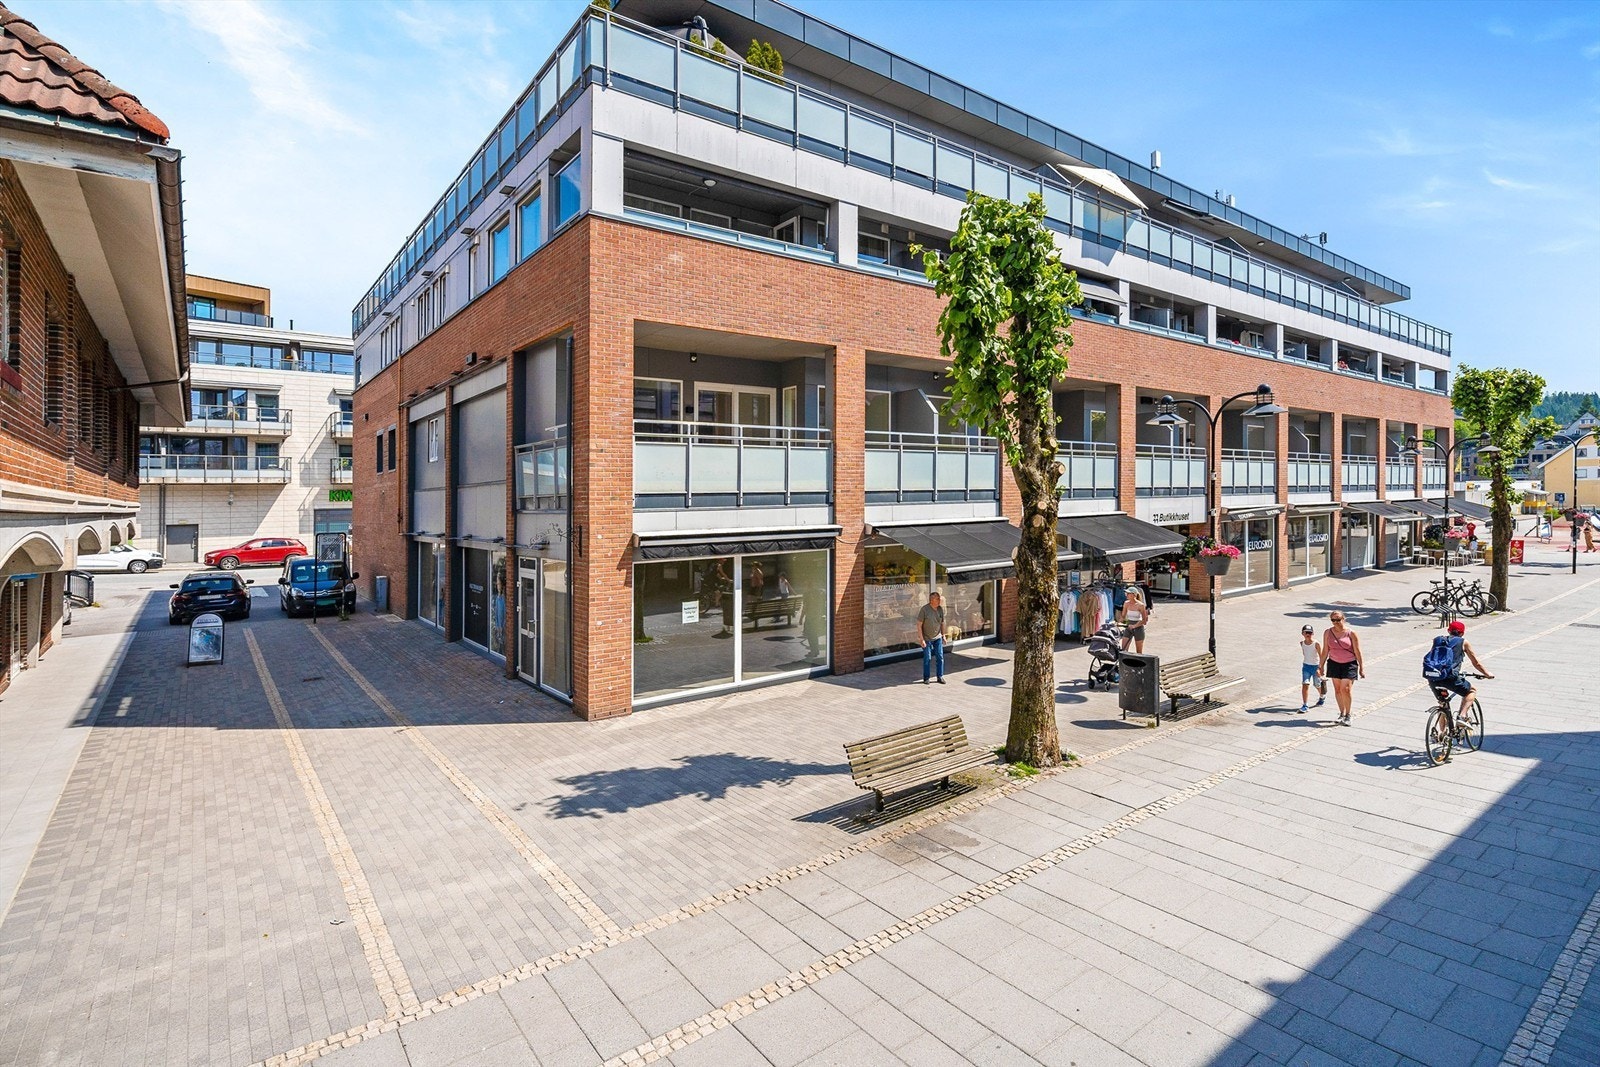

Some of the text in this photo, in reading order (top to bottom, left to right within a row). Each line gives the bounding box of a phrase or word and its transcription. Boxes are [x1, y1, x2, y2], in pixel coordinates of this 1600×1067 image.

[329, 489, 352, 501] KIW
[1159, 512, 1190, 522] Butikkhuset
[1308, 533, 1329, 544] EUROSKO
[1248, 539, 1273, 551] EUROSKO
